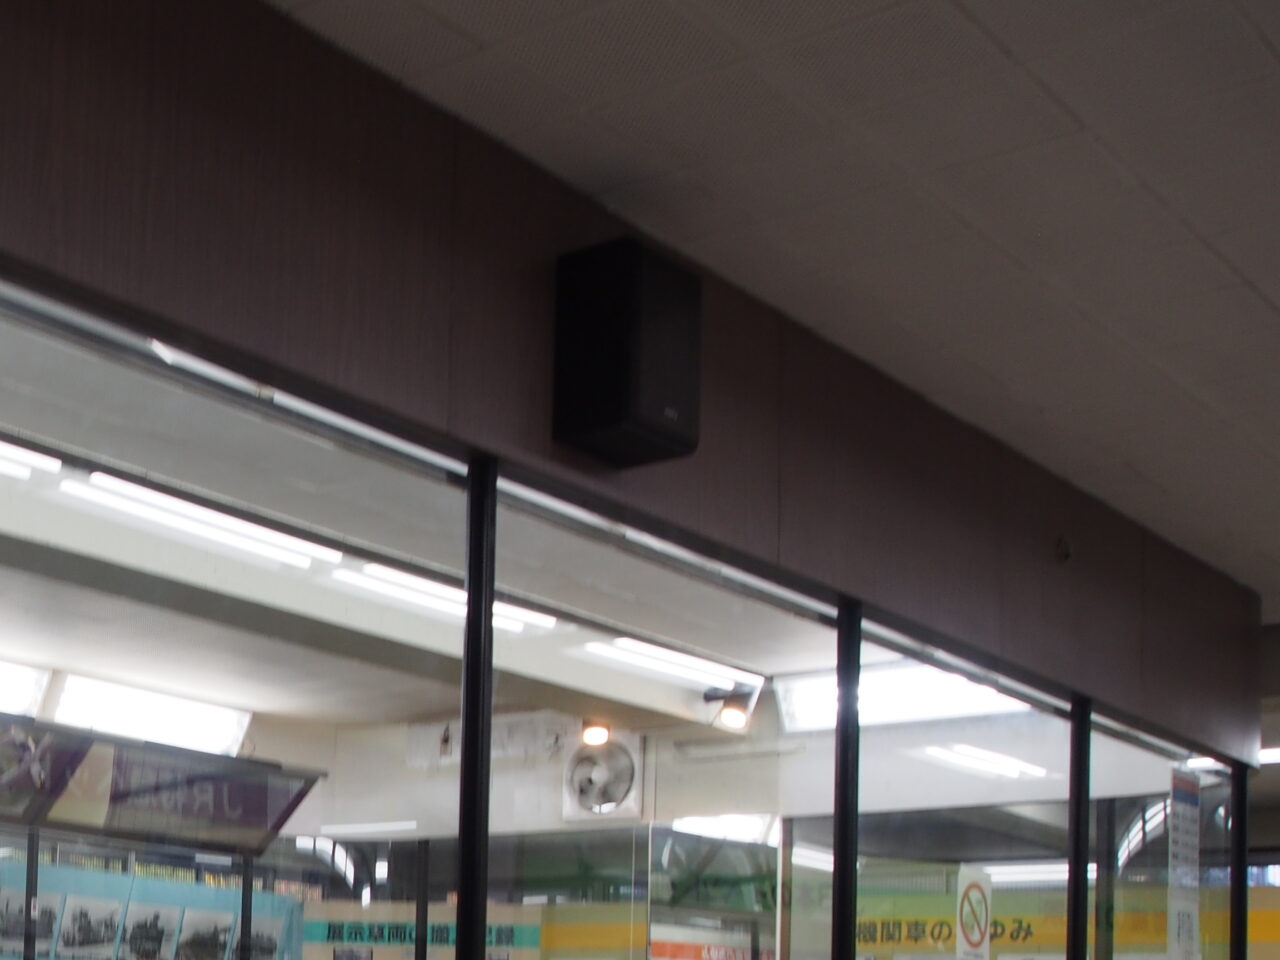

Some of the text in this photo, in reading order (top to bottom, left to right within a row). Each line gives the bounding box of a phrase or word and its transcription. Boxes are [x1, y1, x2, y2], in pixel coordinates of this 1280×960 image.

[857, 918, 1034, 944] 機関車のゆみ
